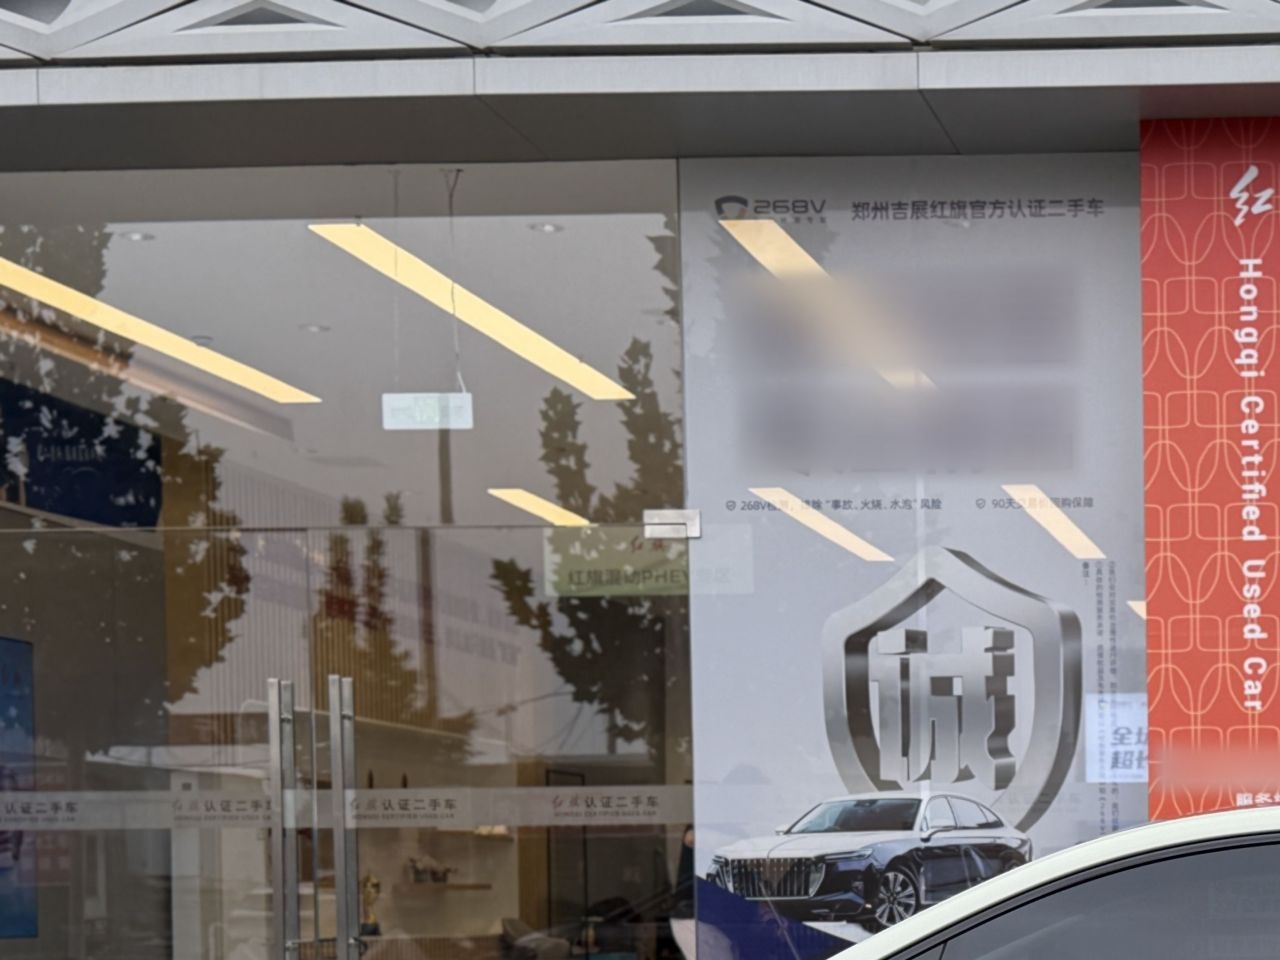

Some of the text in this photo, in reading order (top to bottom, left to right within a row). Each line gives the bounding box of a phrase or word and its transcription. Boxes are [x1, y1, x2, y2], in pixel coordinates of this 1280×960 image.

[753, 199, 826, 214] 268V
[851, 197, 1105, 222] 郑州吉展红旗官方认证二手车
[1234, 259, 1268, 710] Hongqi Certified Used Car
